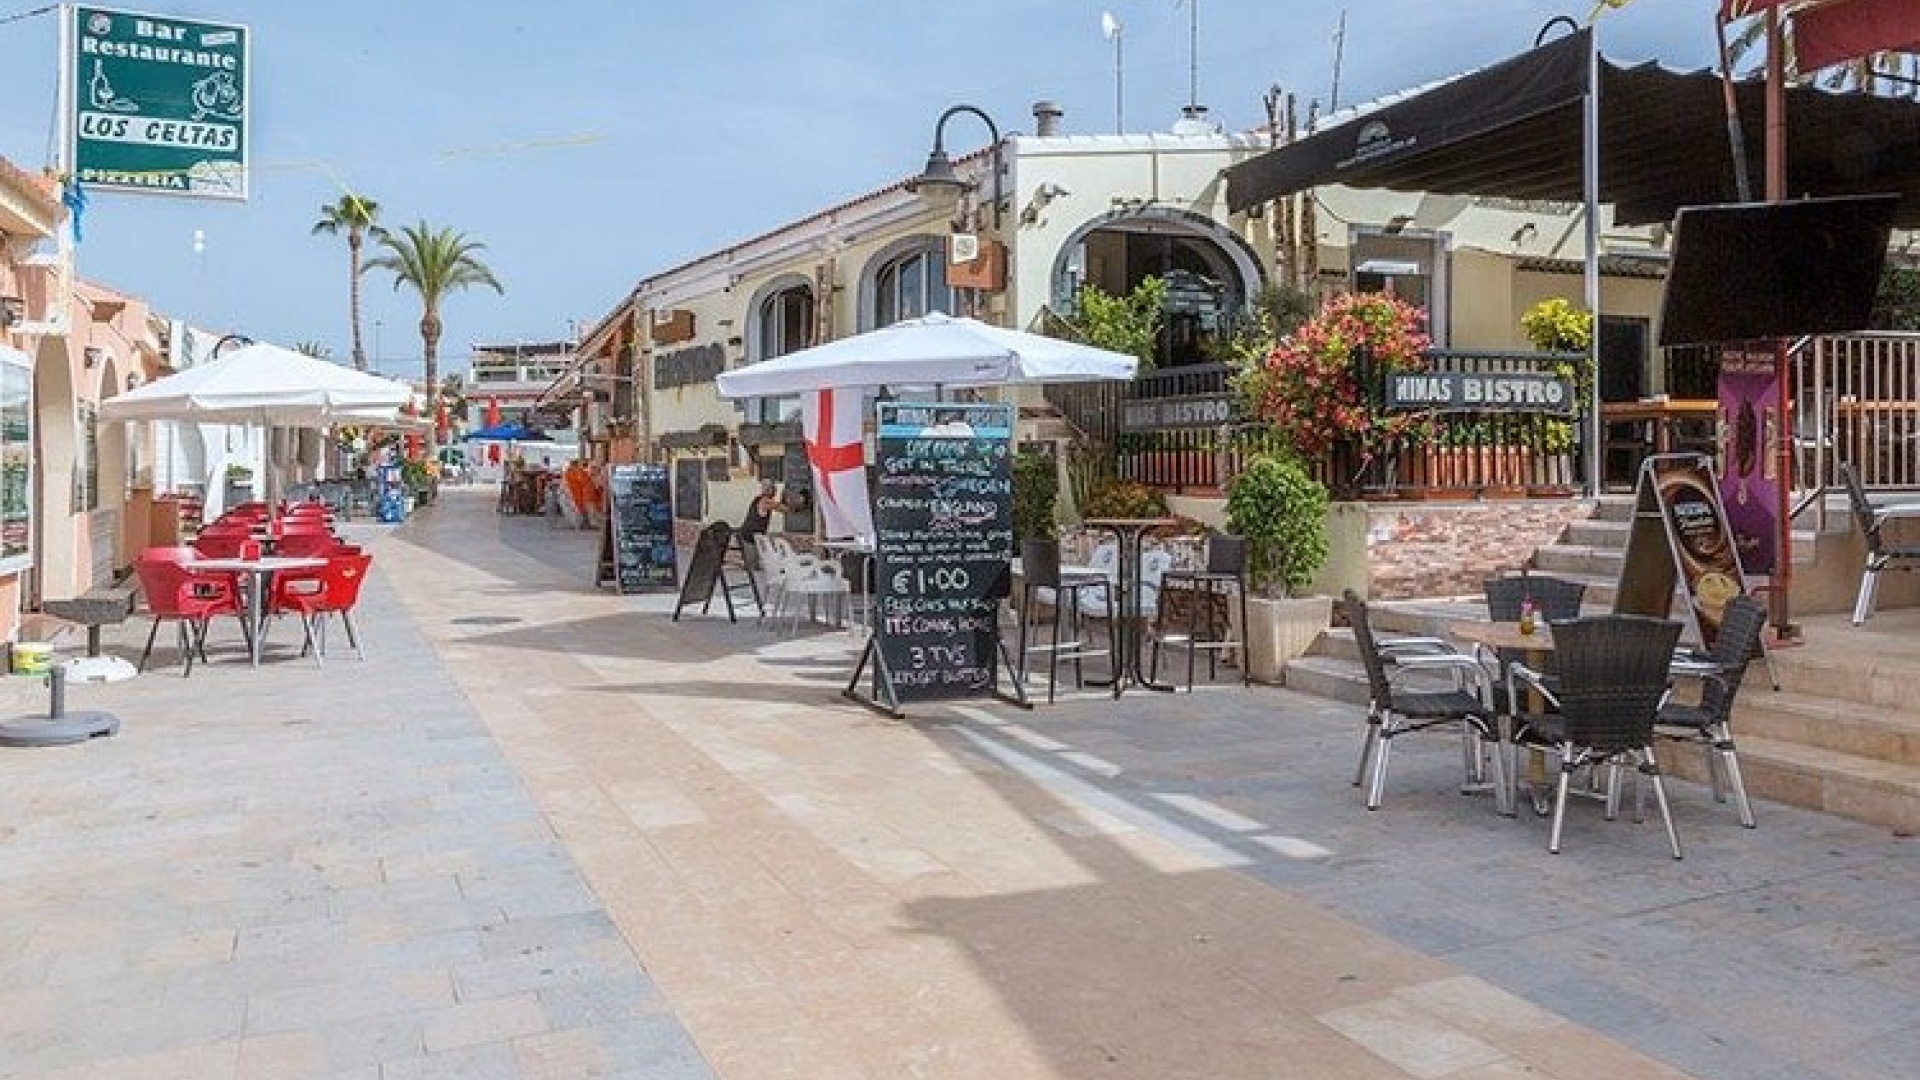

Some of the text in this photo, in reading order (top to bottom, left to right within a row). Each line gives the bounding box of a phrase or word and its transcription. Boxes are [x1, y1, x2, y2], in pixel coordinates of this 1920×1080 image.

[136, 20, 188, 40] Bar
[83, 36, 236, 70] Restaurante
[83, 115, 234, 147] LOS CELTAS
[1463, 378, 1563, 403] BISTRO
[910, 646, 926, 669] 3
